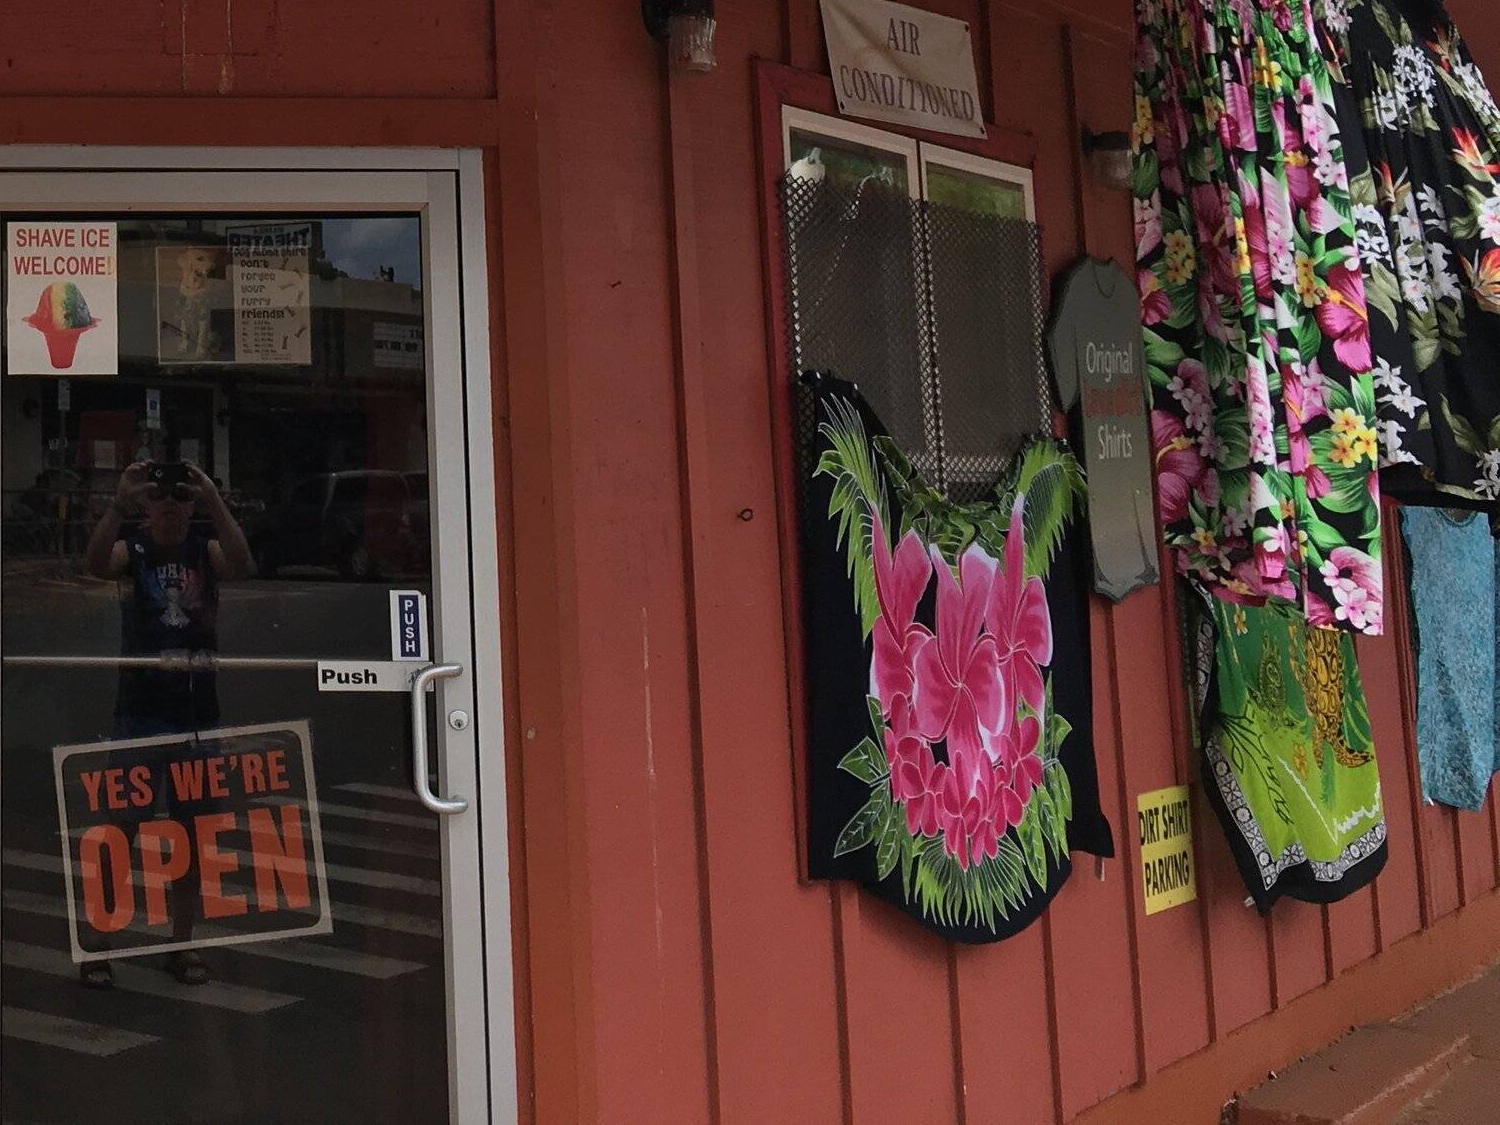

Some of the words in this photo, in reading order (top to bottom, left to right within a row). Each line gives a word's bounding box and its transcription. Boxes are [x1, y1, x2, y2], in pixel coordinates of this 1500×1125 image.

[886, 17, 922, 57] AIR
[839, 64, 975, 122] CONDITIONED
[16, 228, 76, 248] SHAVE
[81, 228, 111, 248] ICE
[1086, 341, 1133, 383] Original
[1097, 424, 1133, 460] Shirts
[404, 599, 416, 652] PUSH
[321, 668, 378, 685] Push
[79, 765, 154, 812] YES
[169, 749, 291, 803] WE'RE
[1137, 807, 1161, 846] DIRT
[1161, 800, 1189, 840] SHIRT
[79, 804, 312, 933] OPEN
[1144, 850, 1190, 897] PARKING
